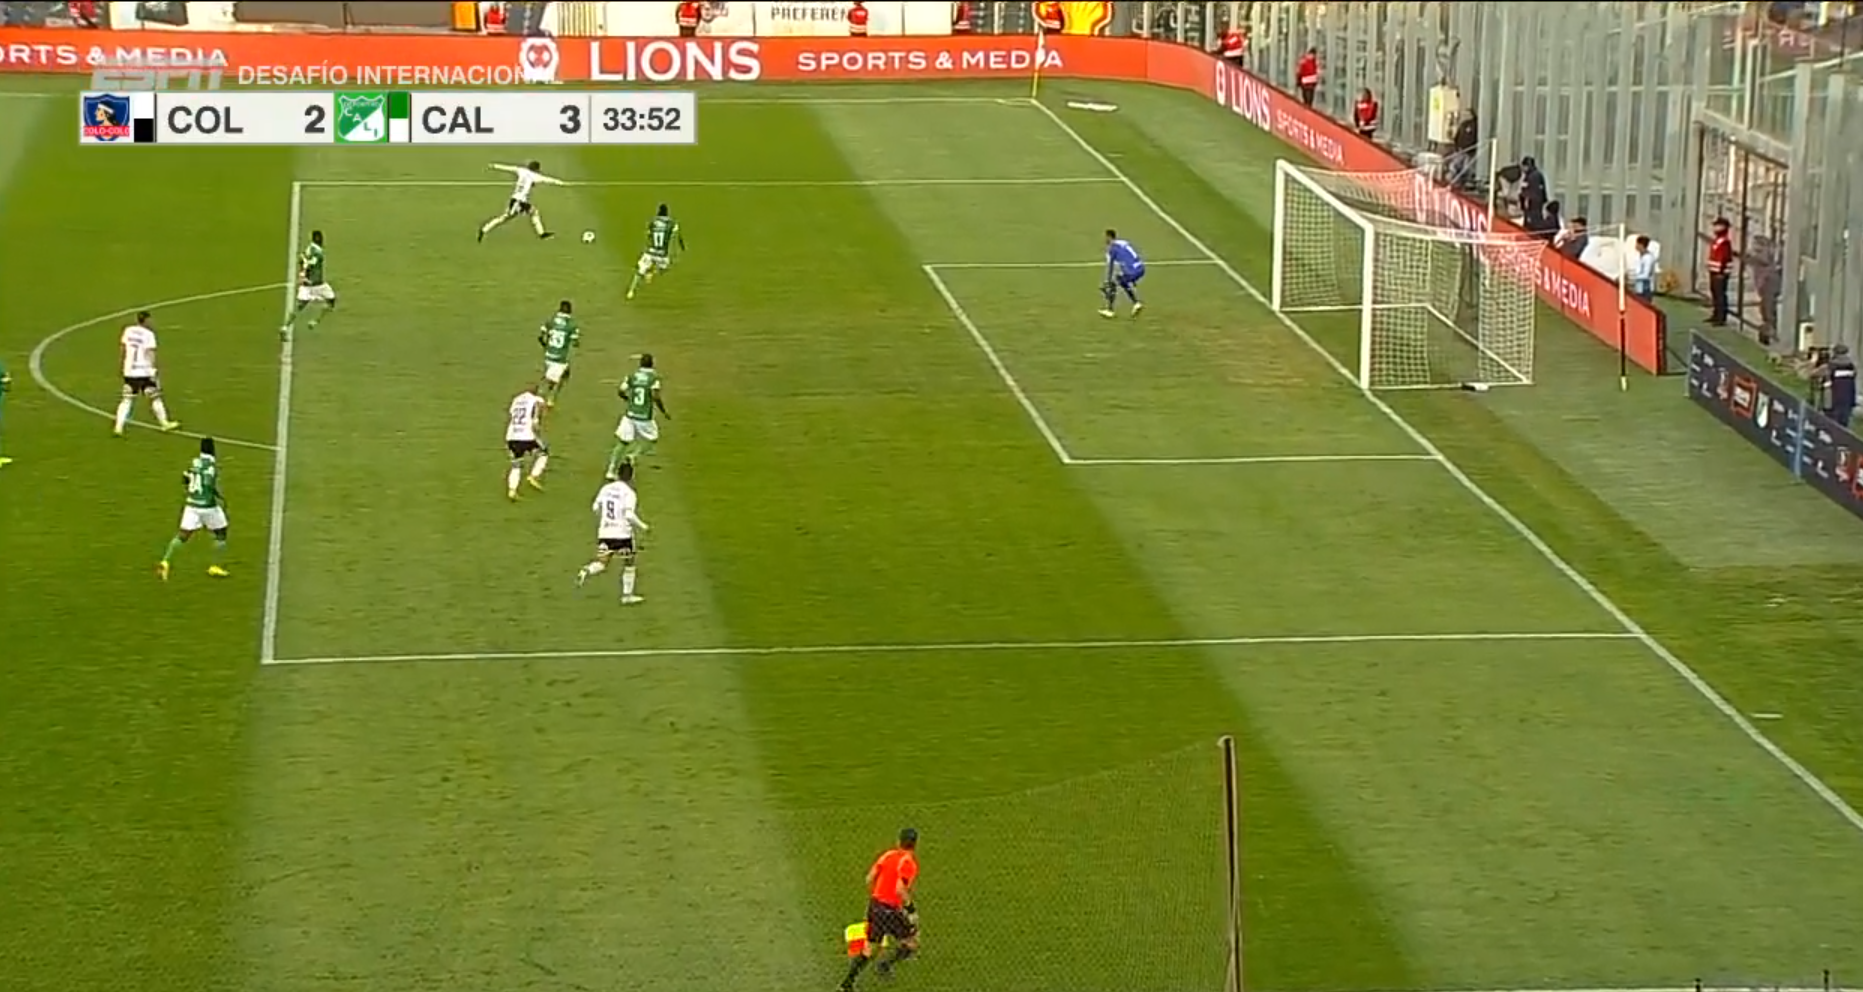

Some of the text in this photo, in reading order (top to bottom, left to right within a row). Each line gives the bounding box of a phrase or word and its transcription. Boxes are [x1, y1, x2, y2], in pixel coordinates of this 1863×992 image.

[0, 44, 77, 65] RTS
[590, 41, 762, 81] LIONS
[797, 51, 927, 70] SPORTS
[935, 51, 954, 70] &
[1231, 70, 1271, 132] LIONS
[1276, 109, 1309, 146] SPORTS
[1316, 132, 1345, 166] MEDIA
[1551, 271, 1590, 318] MEDIA
[633, 387, 645, 406] 3
[513, 407, 526, 425] 22
